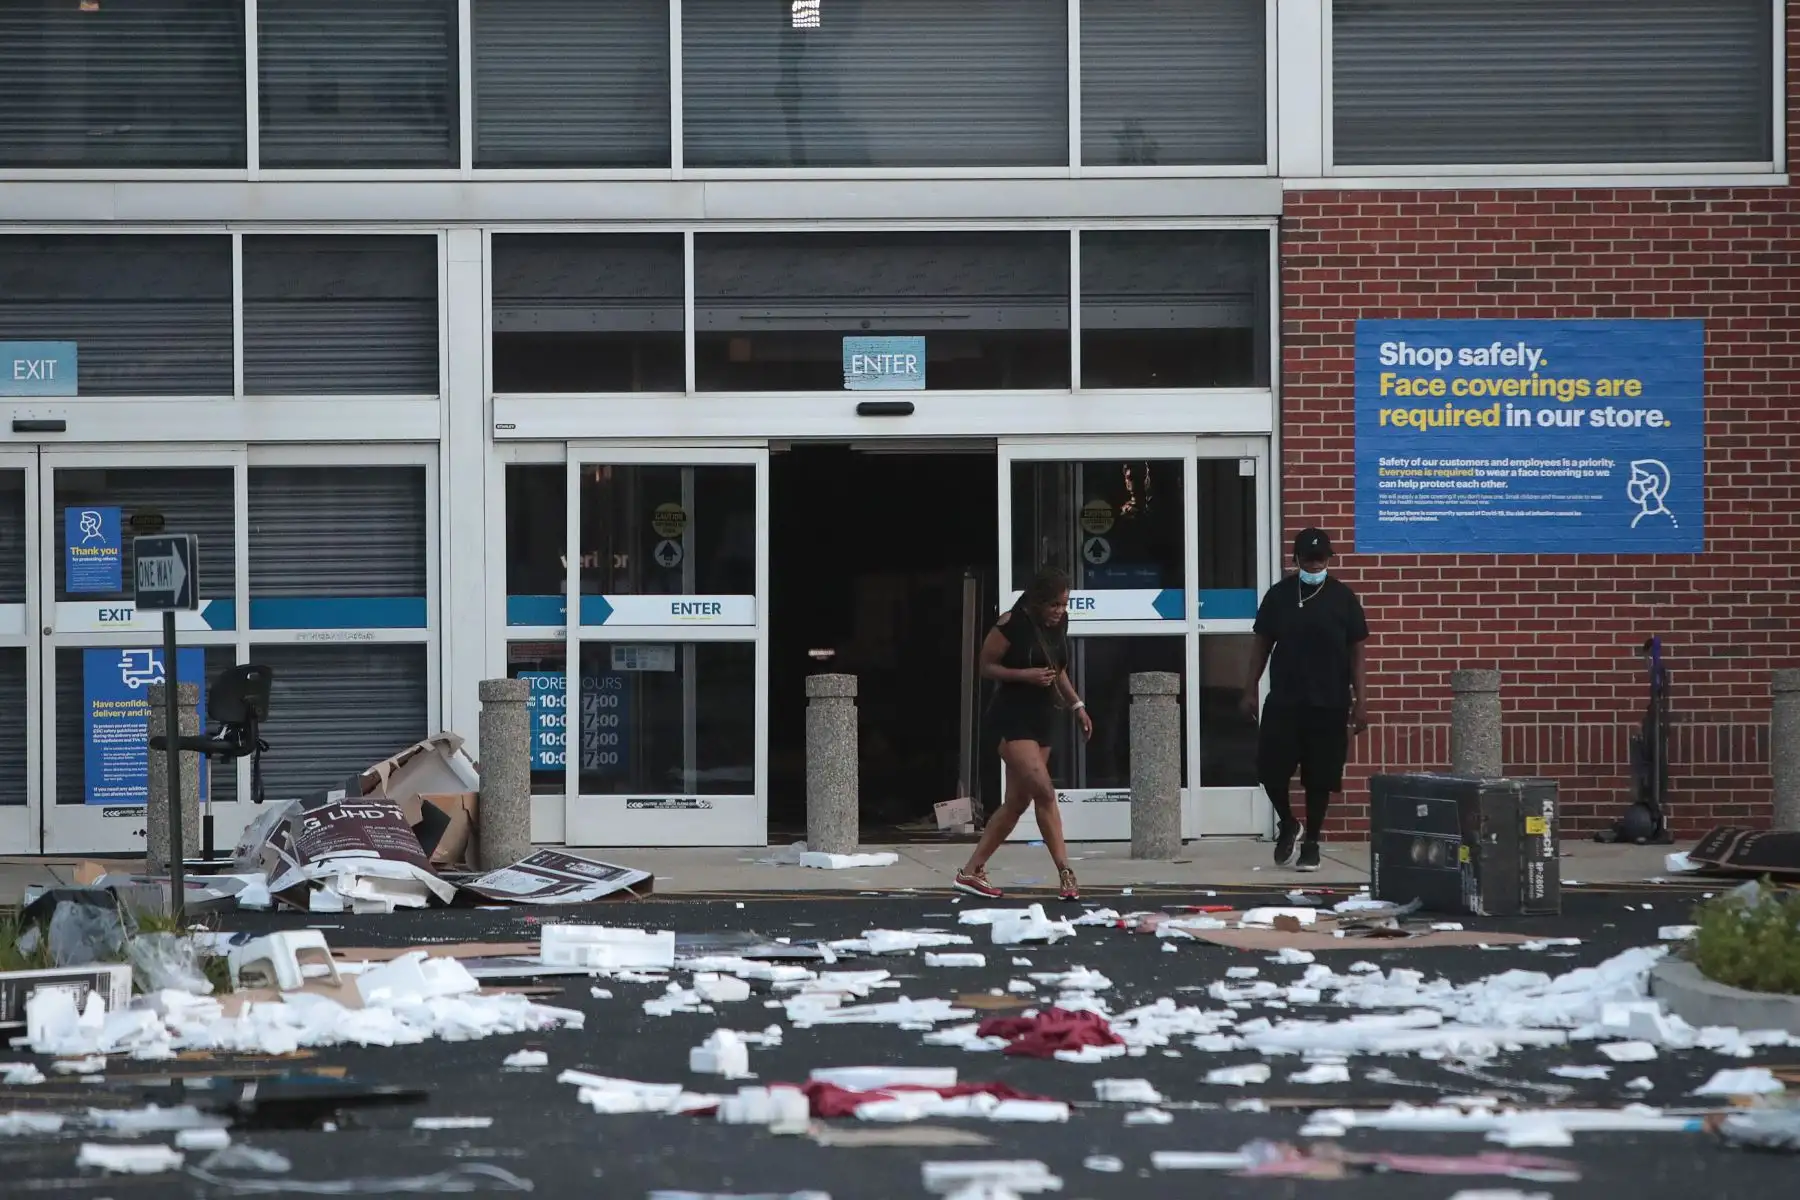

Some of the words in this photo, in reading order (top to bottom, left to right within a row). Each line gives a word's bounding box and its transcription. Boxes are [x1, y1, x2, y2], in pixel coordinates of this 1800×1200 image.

[1379, 341, 1453, 371] Shop
[1458, 341, 1548, 371] safely.
[13, 359, 57, 380] EXIT
[852, 354, 918, 374] ENTER
[1379, 372, 1447, 397] Face
[1451, 372, 1590, 402] coverings
[1595, 378, 1642, 397] are
[1379, 402, 1500, 432] required
[1506, 403, 1531, 427] in
[1536, 408, 1585, 427] our
[1590, 405, 1672, 427] store.
[1379, 458, 1409, 468] Safety
[1411, 458, 1420, 466] of
[1440, 458, 1490, 466] customers
[1490, 458, 1508, 466] and
[1510, 458, 1561, 468] employees
[1562, 458, 1571, 466] is
[1579, 458, 1616, 468] priority.
[1379, 468, 1422, 478] Everyone
[1424, 468, 1432, 476] is
[1434, 468, 1473, 478] required
[1475, 468, 1485, 476] to
[1518, 468, 1539, 476] face
[1540, 468, 1582, 478] covering
[1398, 480, 1418, 489] help
[1420, 480, 1455, 489] protect
[1456, 480, 1480, 488] each
[1480, 480, 1508, 488] other.
[70, 546, 98, 556] Thank
[100, 548, 118, 556] you
[139, 562, 155, 588] ONE
[156, 559, 174, 587] WAY
[671, 602, 722, 614] ENTER
[1068, 597, 1096, 610] TER
[98, 608, 134, 622] EXIT
[582, 676, 622, 690] OURS
[92, 700, 114, 708] Have
[92, 710, 126, 718] delivery
[127, 708, 142, 716] and
[328, 809, 385, 821] UHD
